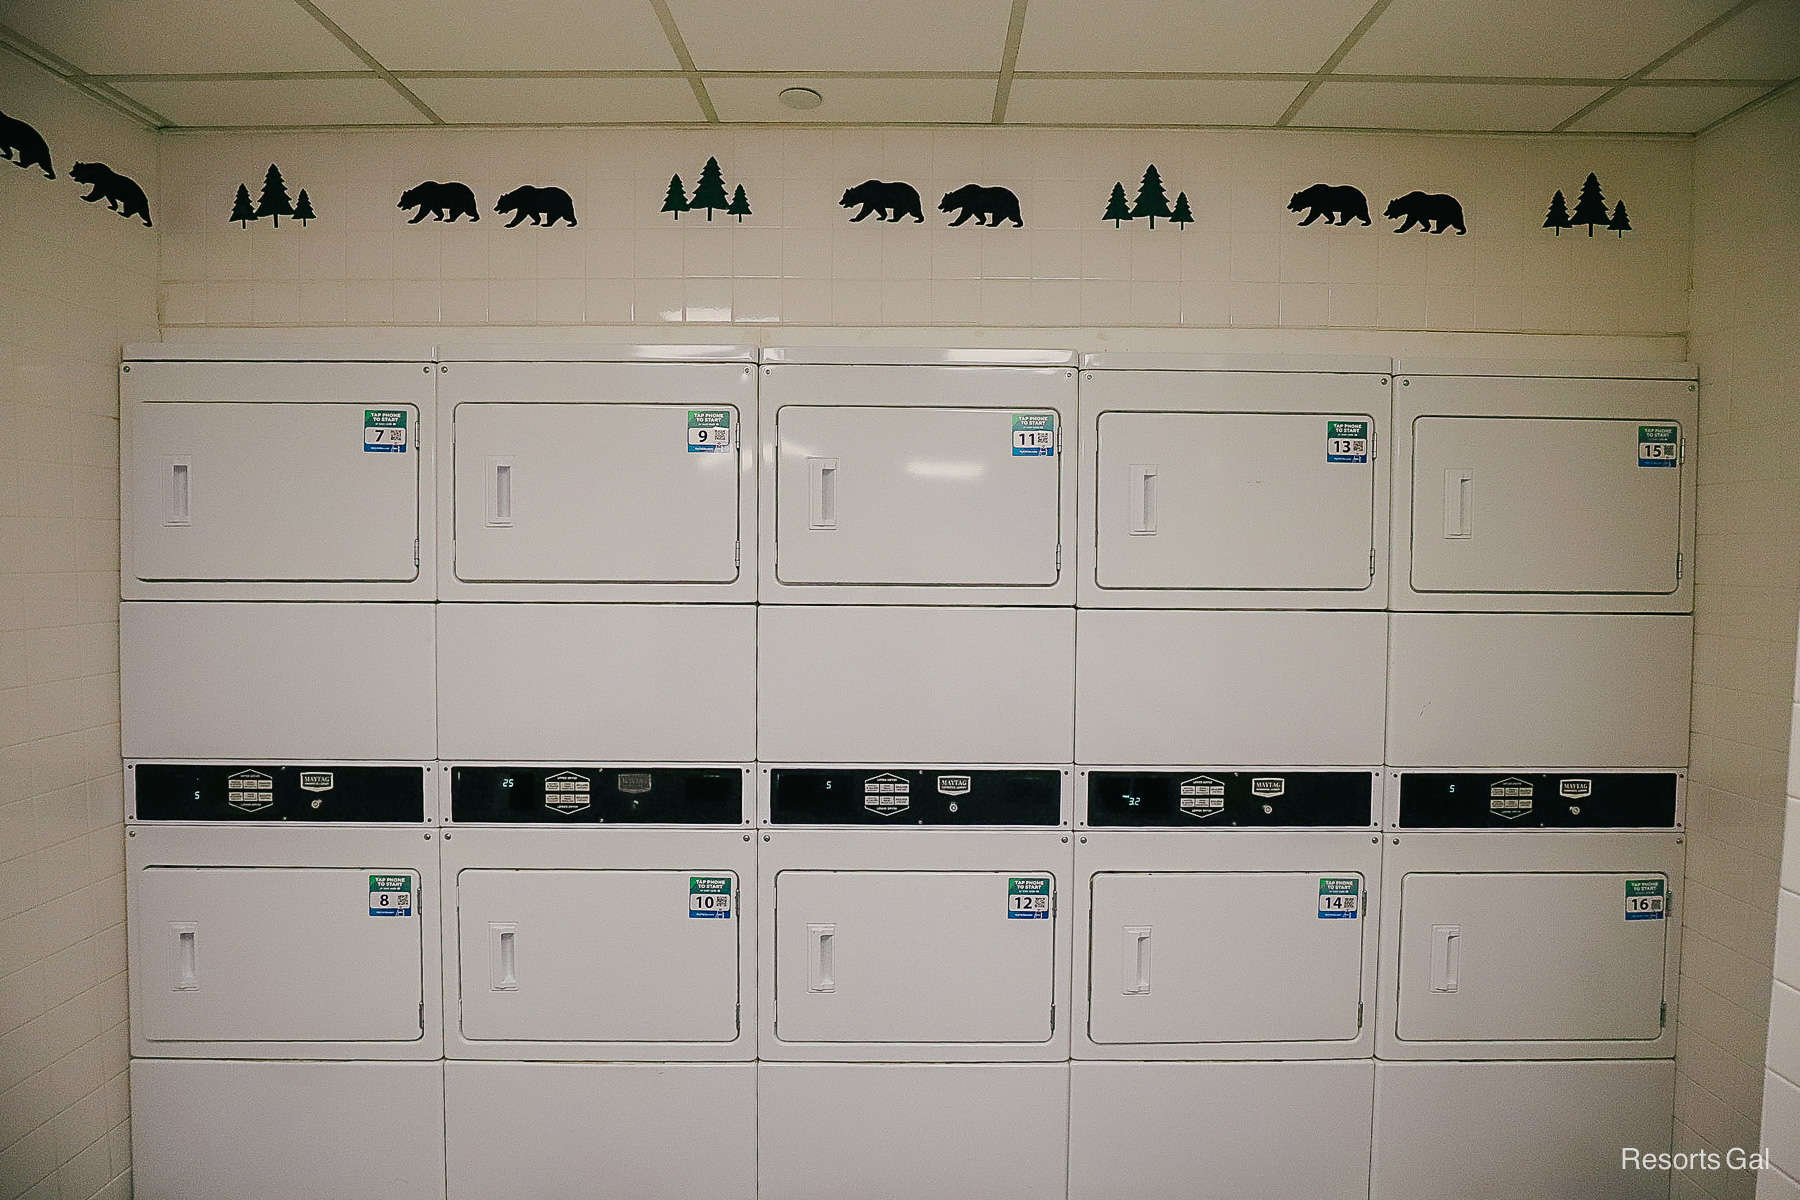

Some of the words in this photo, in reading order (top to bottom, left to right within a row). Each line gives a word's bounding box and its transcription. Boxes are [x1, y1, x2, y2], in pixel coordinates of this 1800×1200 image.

[375, 430, 384, 442] 7
[698, 430, 708, 442] 9
[1019, 434, 1034, 445] 11
[1334, 441, 1351, 452] 13
[1645, 445, 1661, 457] 15
[502, 778, 514, 788] 25
[380, 894, 389, 906] 8
[696, 896, 714, 908] 10
[1015, 897, 1032, 909] 12
[1326, 897, 1342, 909] 14
[1632, 899, 1649, 910] 16
